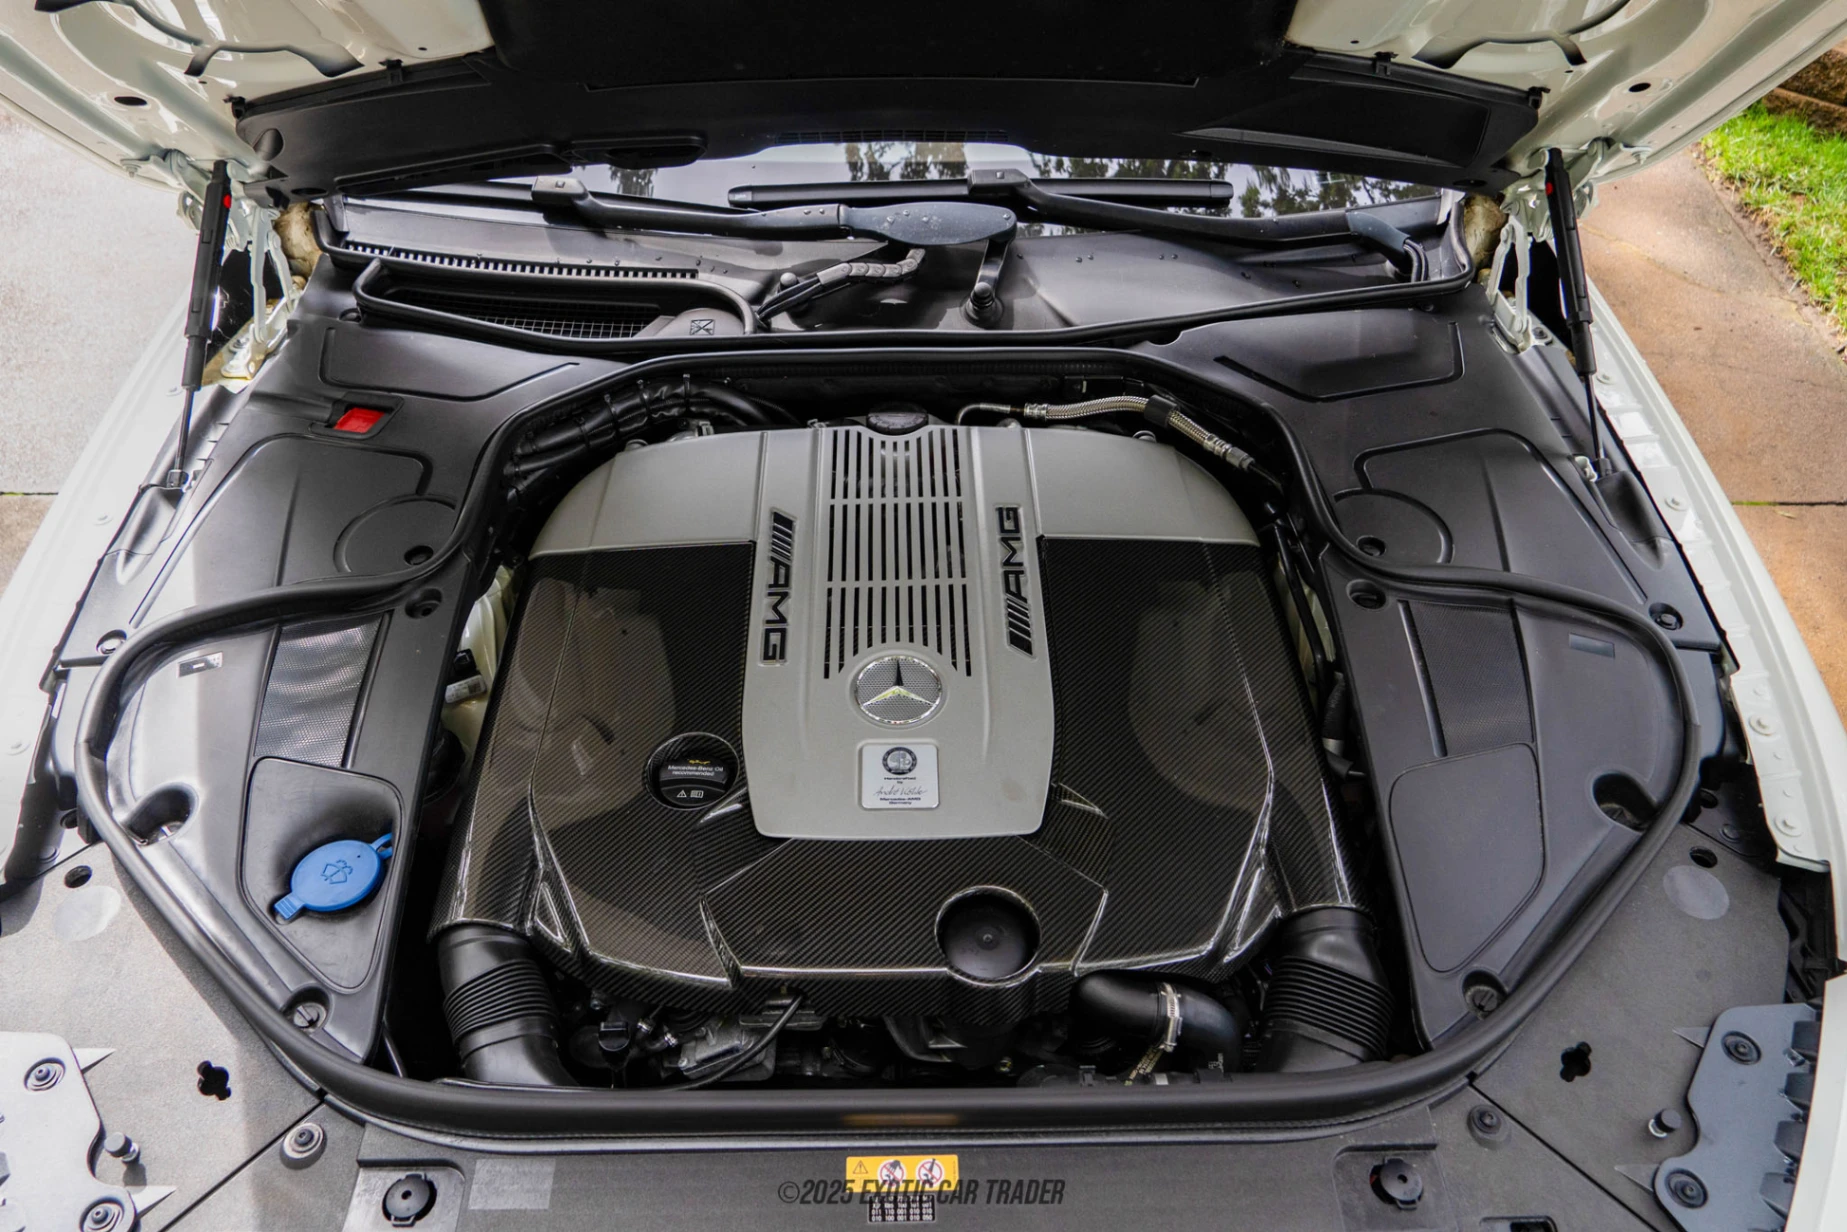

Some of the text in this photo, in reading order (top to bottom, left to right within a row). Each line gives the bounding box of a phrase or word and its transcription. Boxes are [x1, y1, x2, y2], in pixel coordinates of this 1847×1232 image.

[994, 506, 1028, 603] AMG
[762, 555, 791, 661] AMG
[667, 764, 714, 772] Mercedes-Benz
